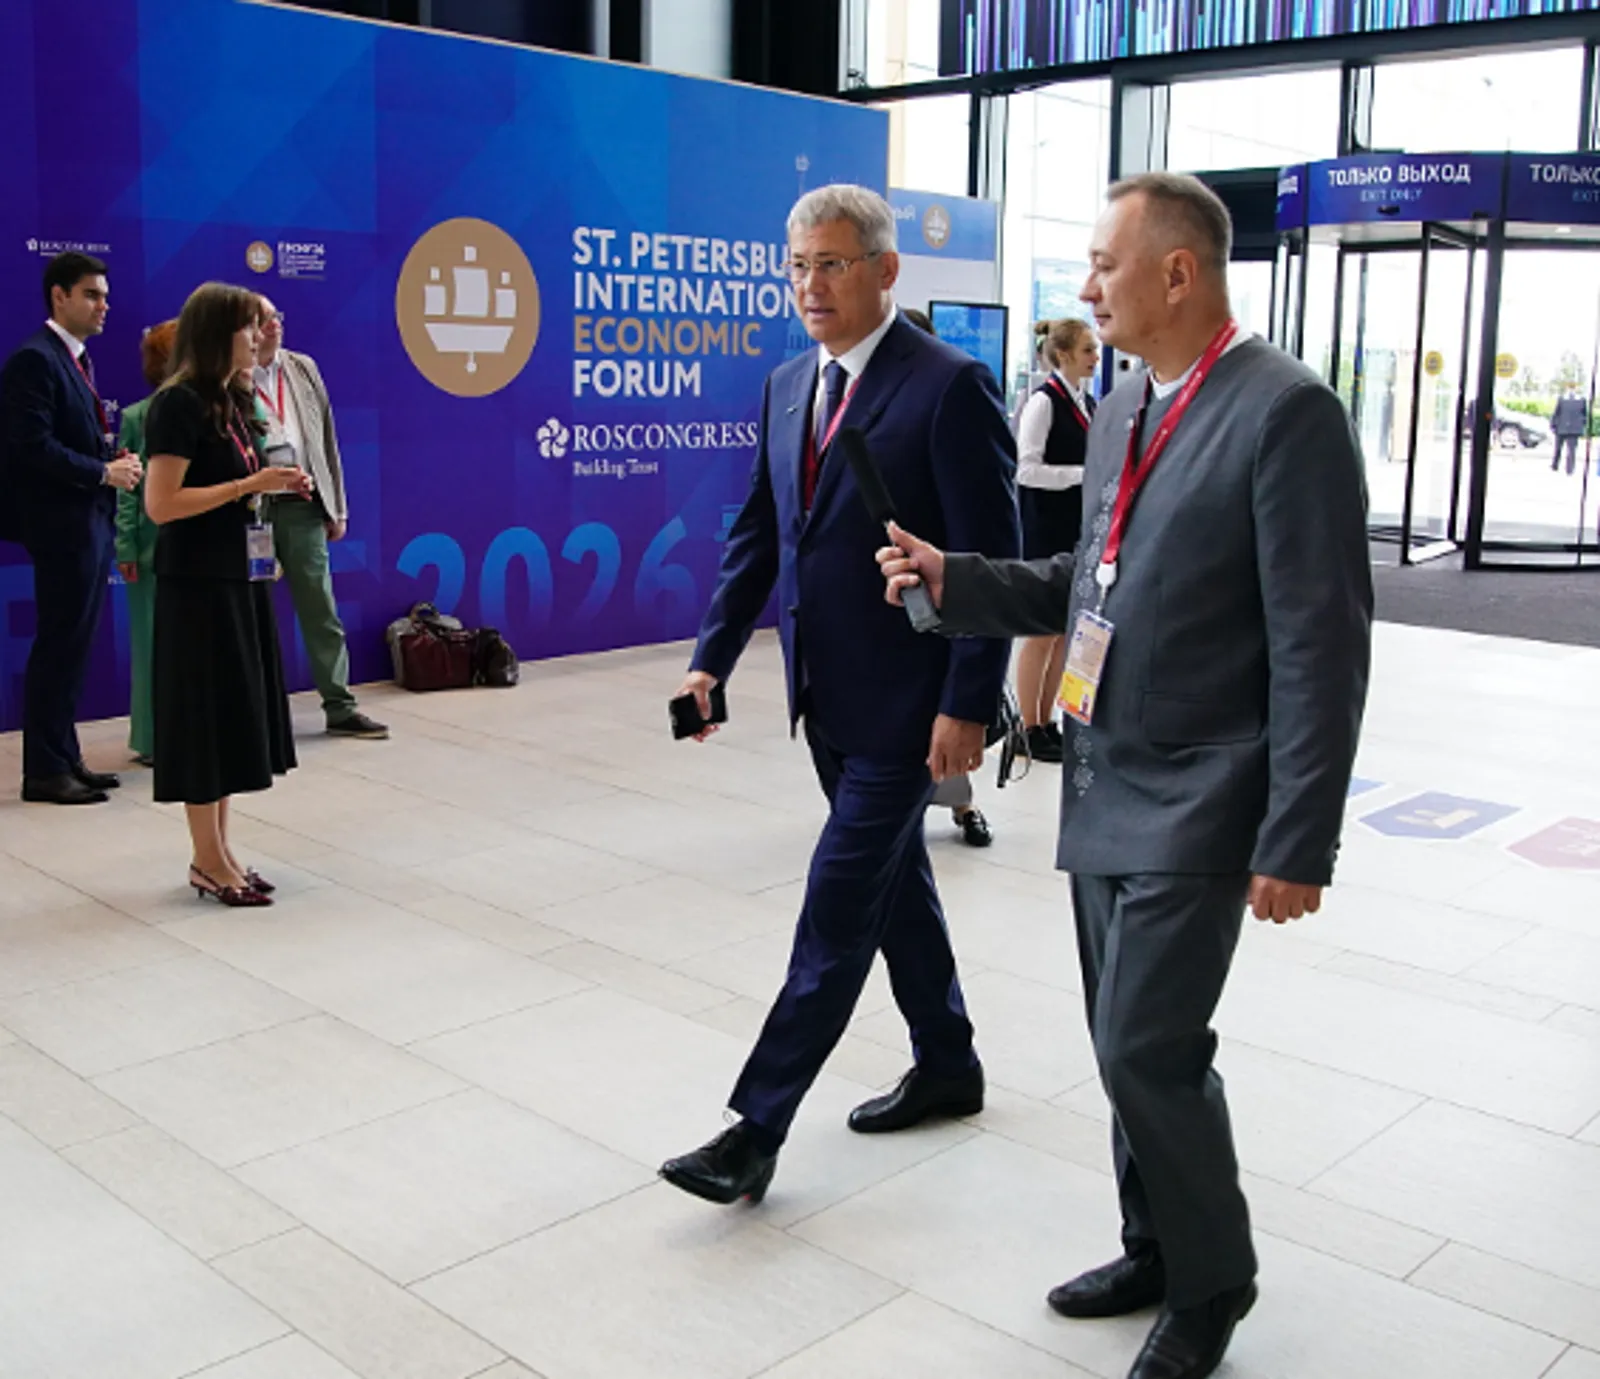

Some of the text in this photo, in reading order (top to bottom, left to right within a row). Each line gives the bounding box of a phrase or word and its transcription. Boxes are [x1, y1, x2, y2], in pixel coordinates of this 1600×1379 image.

[1328, 163, 1471, 187] ТОЛЬКО ВЫХОД
[1529, 164, 1600, 185] ТОЛЬКО
[573, 226, 789, 278] ST. PETERSBU
[574, 271, 797, 318] INTERNATION
[574, 316, 761, 355] ECONOMIC
[573, 360, 701, 397] FORUM
[572, 422, 758, 451] ROSCONGRESS
[396, 514, 698, 634] 2026
